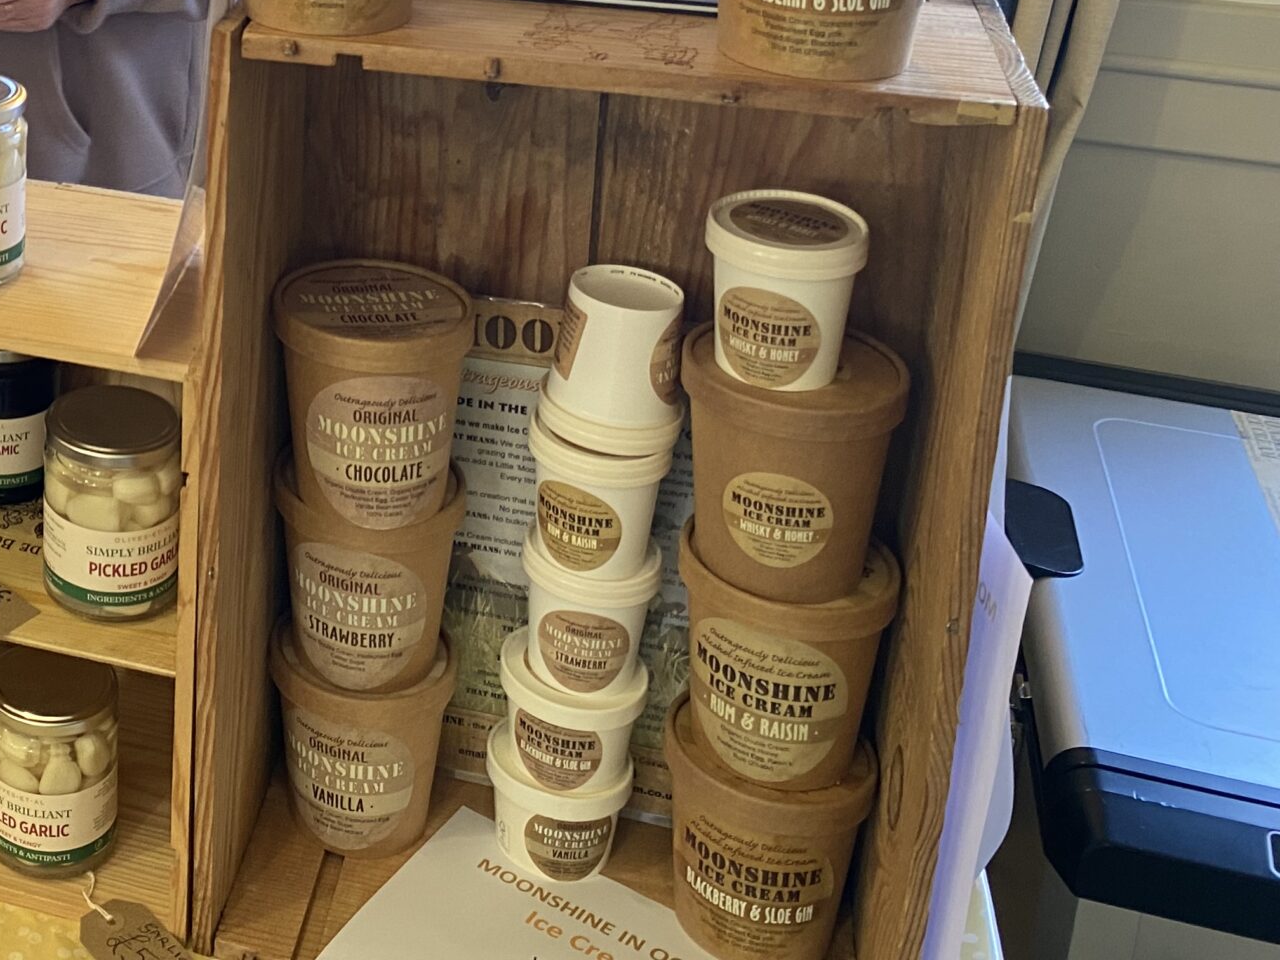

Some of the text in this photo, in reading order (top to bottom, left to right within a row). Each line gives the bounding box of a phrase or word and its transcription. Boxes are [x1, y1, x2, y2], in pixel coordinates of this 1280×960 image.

[723, 304, 812, 338] MOONSHINE
[334, 392, 396, 409] Outrageously
[477, 399, 528, 415] IN THE
[317, 412, 448, 444] MOONSHINE
[353, 409, 419, 425] ORIGINAL
[335, 442, 432, 461] ICE CREAM
[345, 461, 423, 483] CHOCOLATE
[739, 519, 814, 543] WHISKY & HONEY
[85, 543, 131, 559] SIMPLY
[88, 560, 148, 578] PICKLED
[294, 569, 418, 615] MOONSHINE
[319, 571, 382, 597] ORIGINAL
[308, 614, 395, 649] STRAWBERRY
[697, 639, 837, 703] MOONSHINE
[709, 671, 814, 719] ICE CREAM
[709, 693, 810, 741] RUM & RAISIN
[7, 802, 73, 819] BRILLIANT
[311, 783, 365, 813] VANILLA
[20, 820, 70, 838] GARLIC
[477, 857, 647, 952] MOONSHINE IN
[524, 910, 564, 939] Ice
